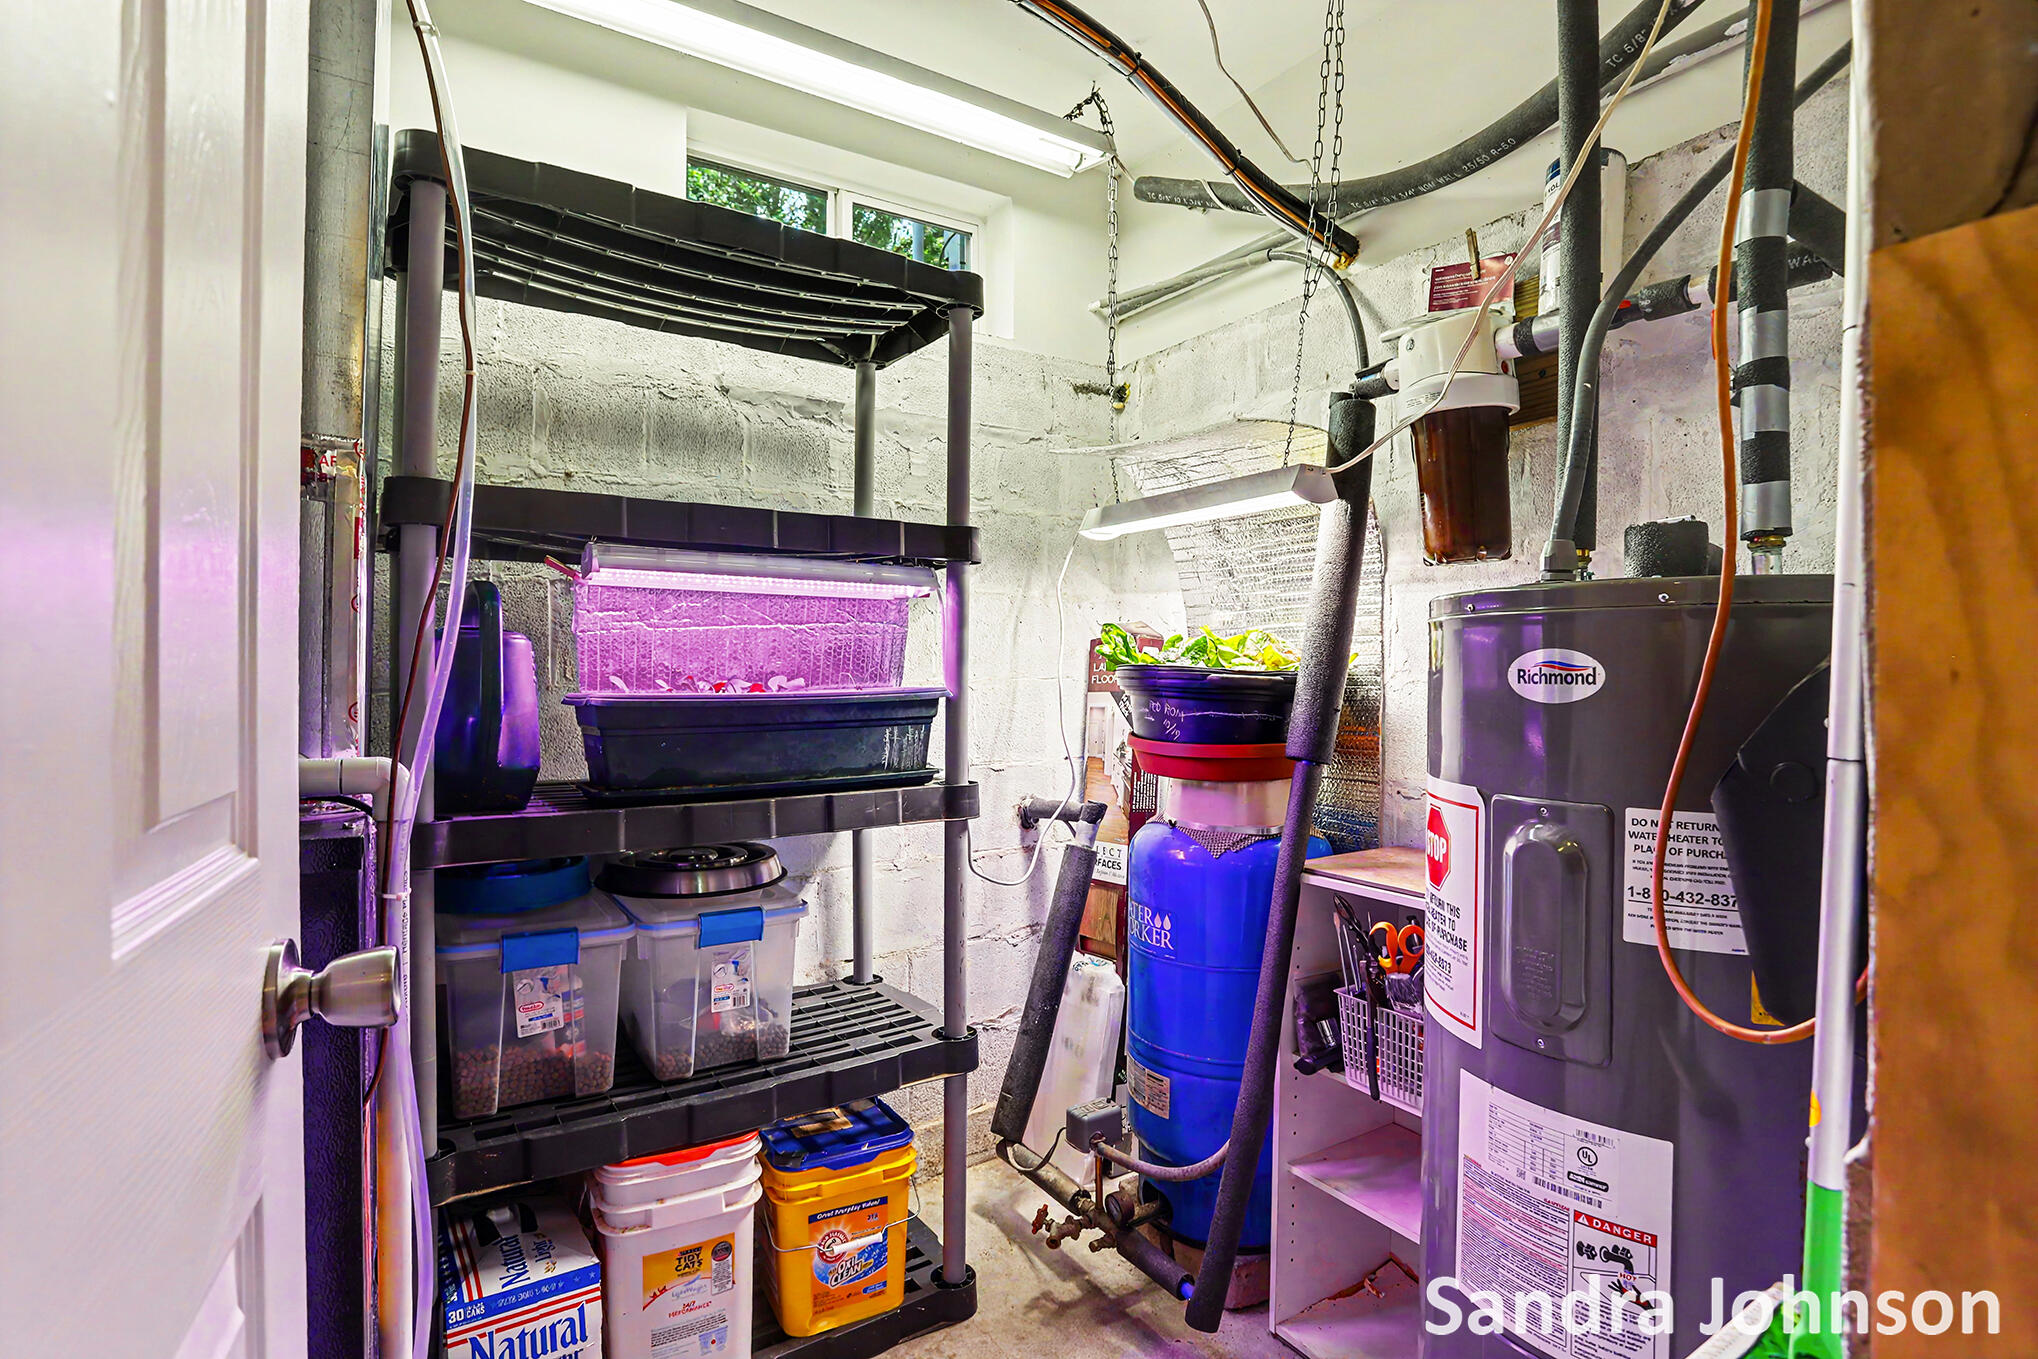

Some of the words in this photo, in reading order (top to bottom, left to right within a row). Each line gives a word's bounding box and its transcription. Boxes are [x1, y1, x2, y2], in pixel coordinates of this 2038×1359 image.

[1604, 53, 1623, 68] TC
[1461, 153, 1490, 173] 25/50
[1517, 666, 1597, 686] Richmond
[1631, 817, 1648, 827] DO
[1628, 830, 1658, 841] WATE
[1667, 834, 1709, 846] HEATER
[1633, 843, 1656, 854] PLA
[1668, 847, 1684, 857] OF
[1686, 848, 1726, 860] PURCH
[1627, 885, 1738, 908] 1-80-432-837
[1446, 902, 1461, 920] THIS
[1448, 917, 1456, 932] TO
[1582, 1149, 1593, 1164] UL
[1592, 1218, 1652, 1245] DANGER
[491, 1234, 531, 1290] Natural
[674, 1258, 704, 1272] CATS
[675, 1252, 701, 1265] TIDY
[830, 1260, 863, 1288] CLEAN
[1619, 1271, 1638, 1282] HOT
[448, 1308, 465, 1324] 30
[467, 1300, 589, 1359] Natural
